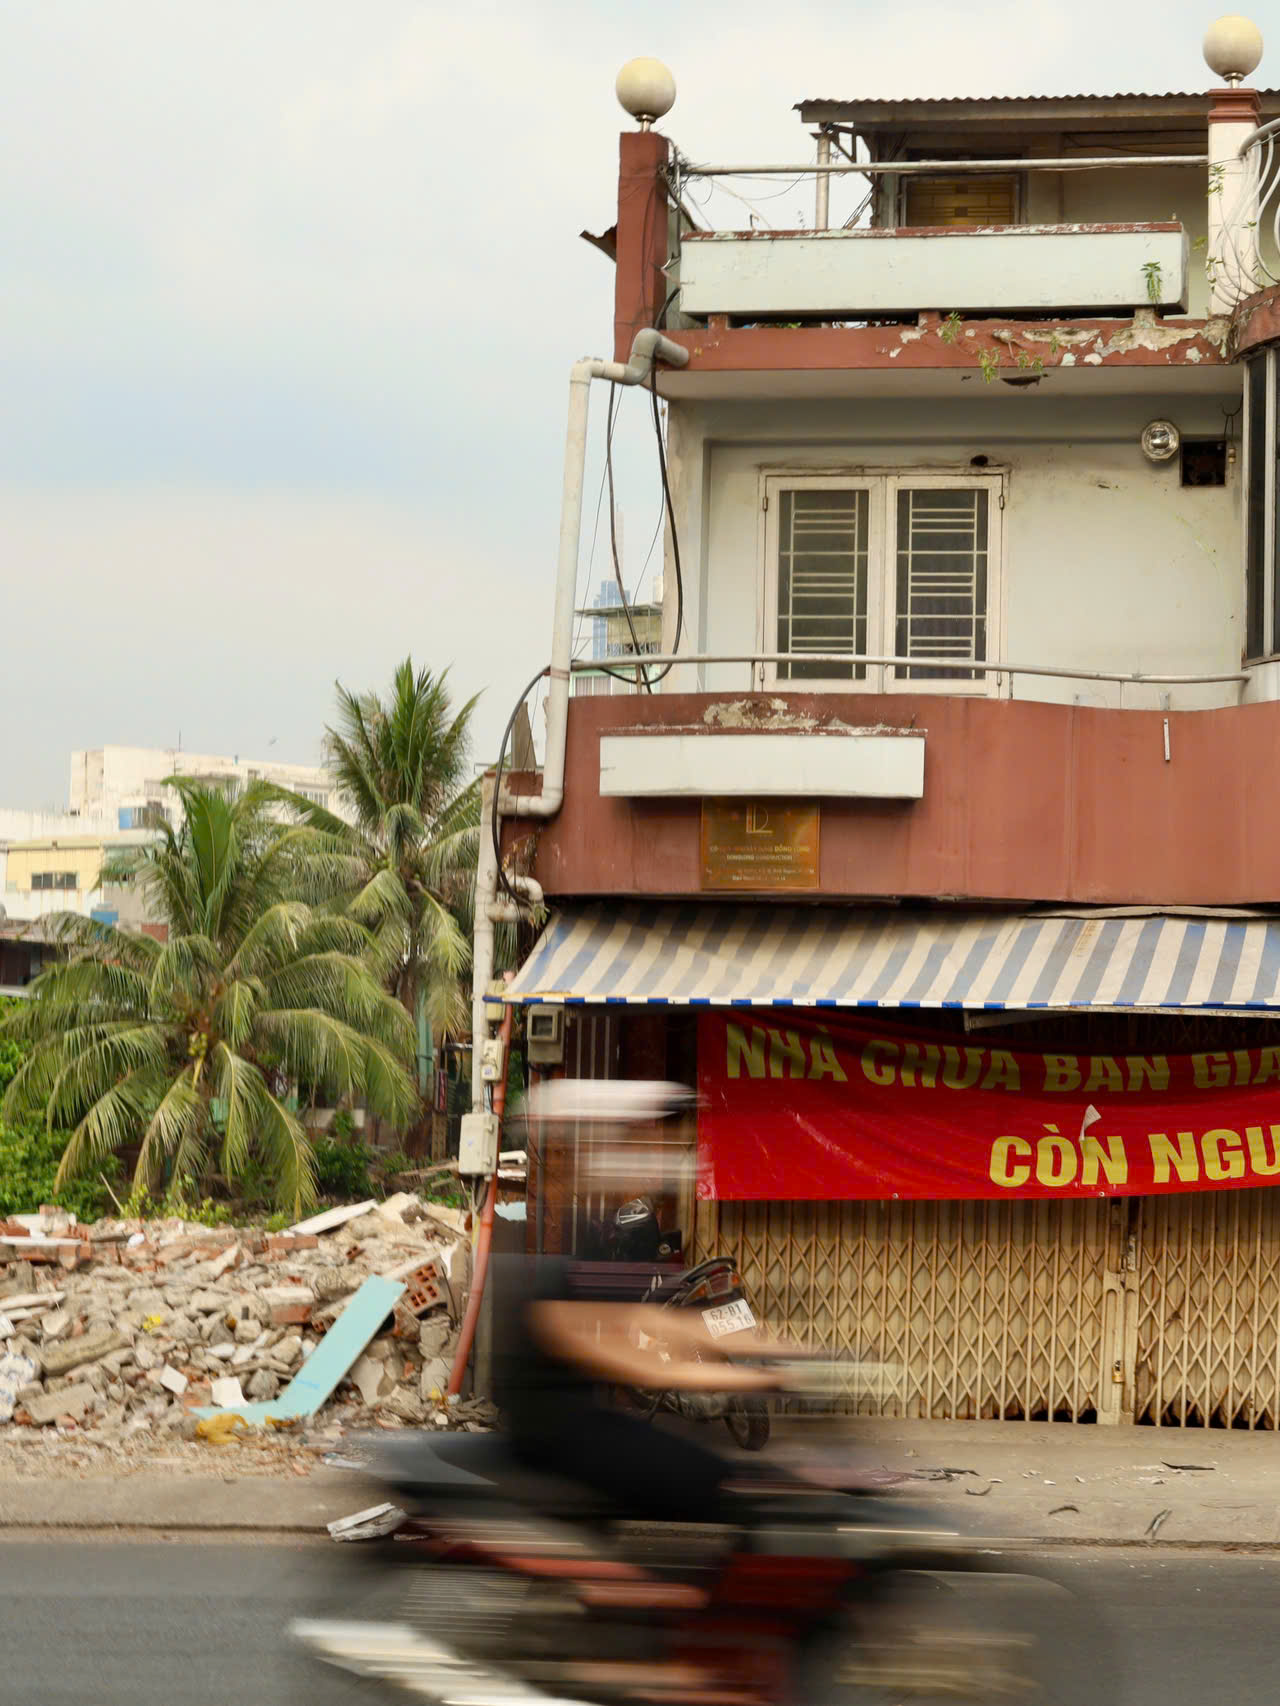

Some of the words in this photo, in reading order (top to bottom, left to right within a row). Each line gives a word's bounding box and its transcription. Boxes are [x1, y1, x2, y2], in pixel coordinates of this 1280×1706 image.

[726, 1023, 849, 1082] NHÀ
[860, 1039, 1021, 1091] CHƯA
[989, 1123, 1129, 1188] CÒN
